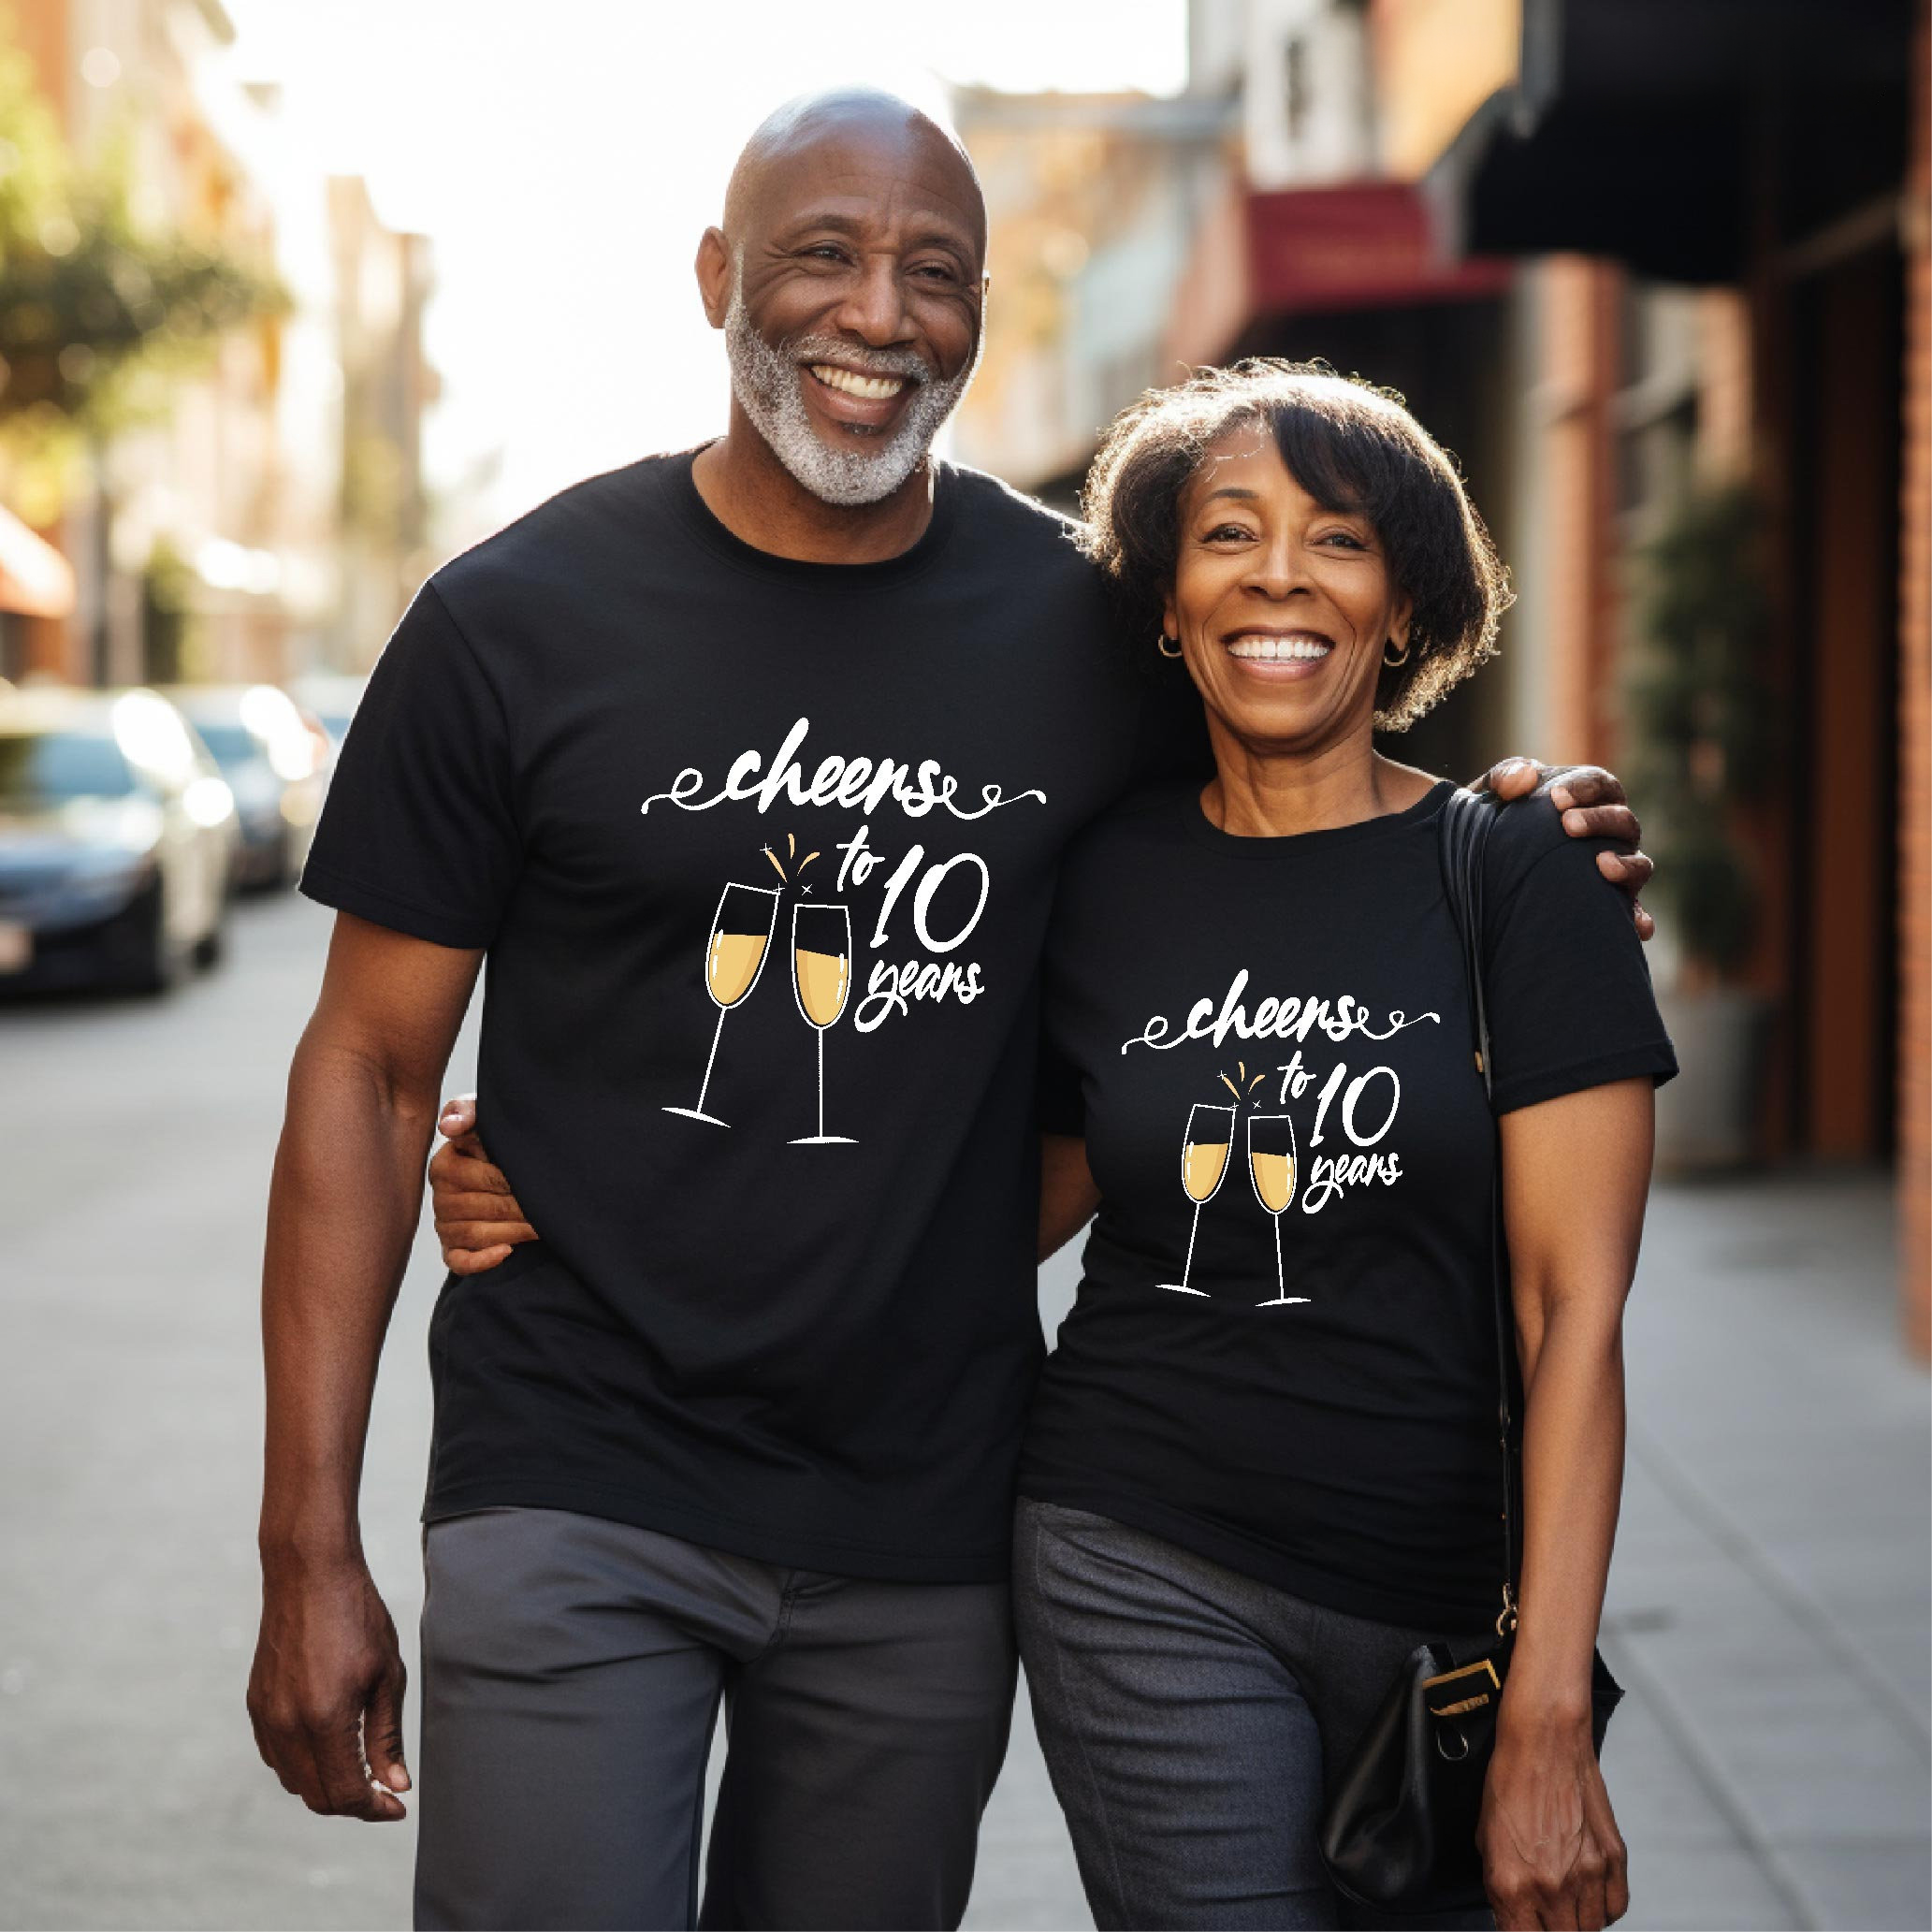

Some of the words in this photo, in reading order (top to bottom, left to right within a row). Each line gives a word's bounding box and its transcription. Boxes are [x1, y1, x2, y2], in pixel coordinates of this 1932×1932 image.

[641, 718, 1046, 820] cheers
[835, 824, 885, 893] to
[869, 844, 990, 953] 10
[853, 959, 985, 1034] years
[1122, 969, 1441, 1054] cheers
[1276, 1050, 1317, 1105] to
[1309, 1062, 1401, 1148] 10
[1301, 1152, 1403, 1214] years
